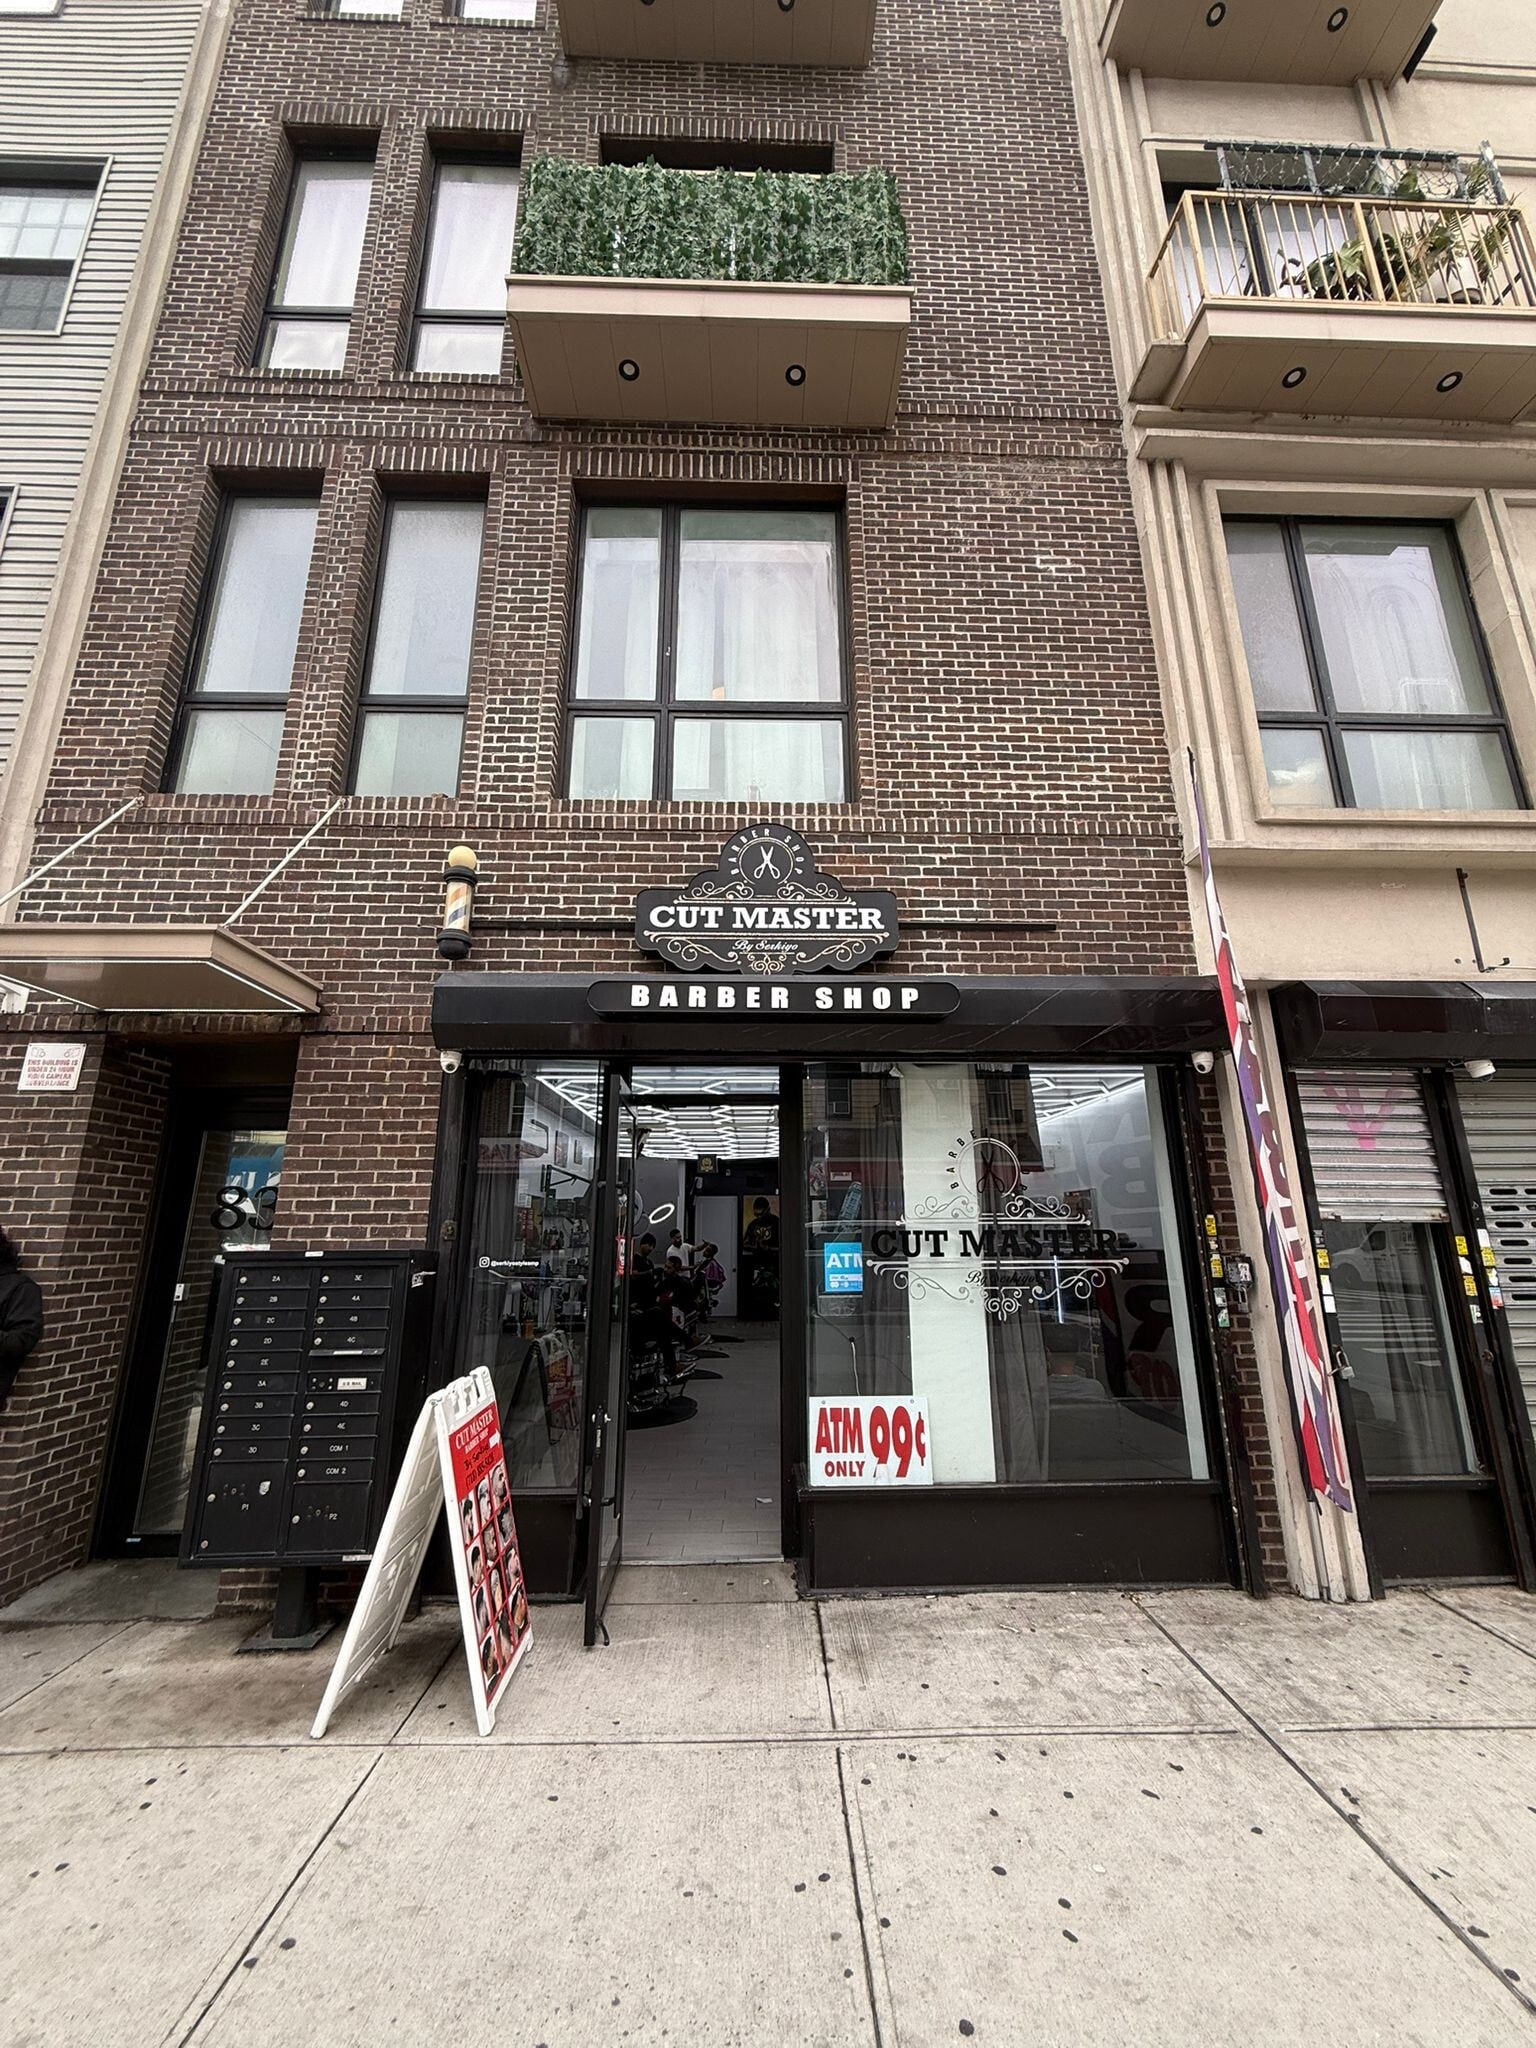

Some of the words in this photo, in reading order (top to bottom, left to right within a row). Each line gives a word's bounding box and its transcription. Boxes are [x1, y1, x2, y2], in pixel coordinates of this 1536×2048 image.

[728, 828, 770, 875] BARBER
[783, 835, 805, 875] SHOP
[649, 905, 724, 929] CUT
[732, 906, 885, 930] MASTER
[732, 940, 752, 951] By
[630, 984, 790, 1009] BARBER
[815, 986, 919, 1010] SHOP
[871, 1229, 949, 1258] CUT
[959, 1229, 1122, 1258] MASTER
[337, 1422, 346, 1430] 4E
[455, 1427, 470, 1450] CUT
[469, 1409, 494, 1440] MASTER
[815, 1407, 864, 1453] ATM
[869, 1405, 926, 1478] 99¢
[824, 1460, 865, 1477] ONLY
